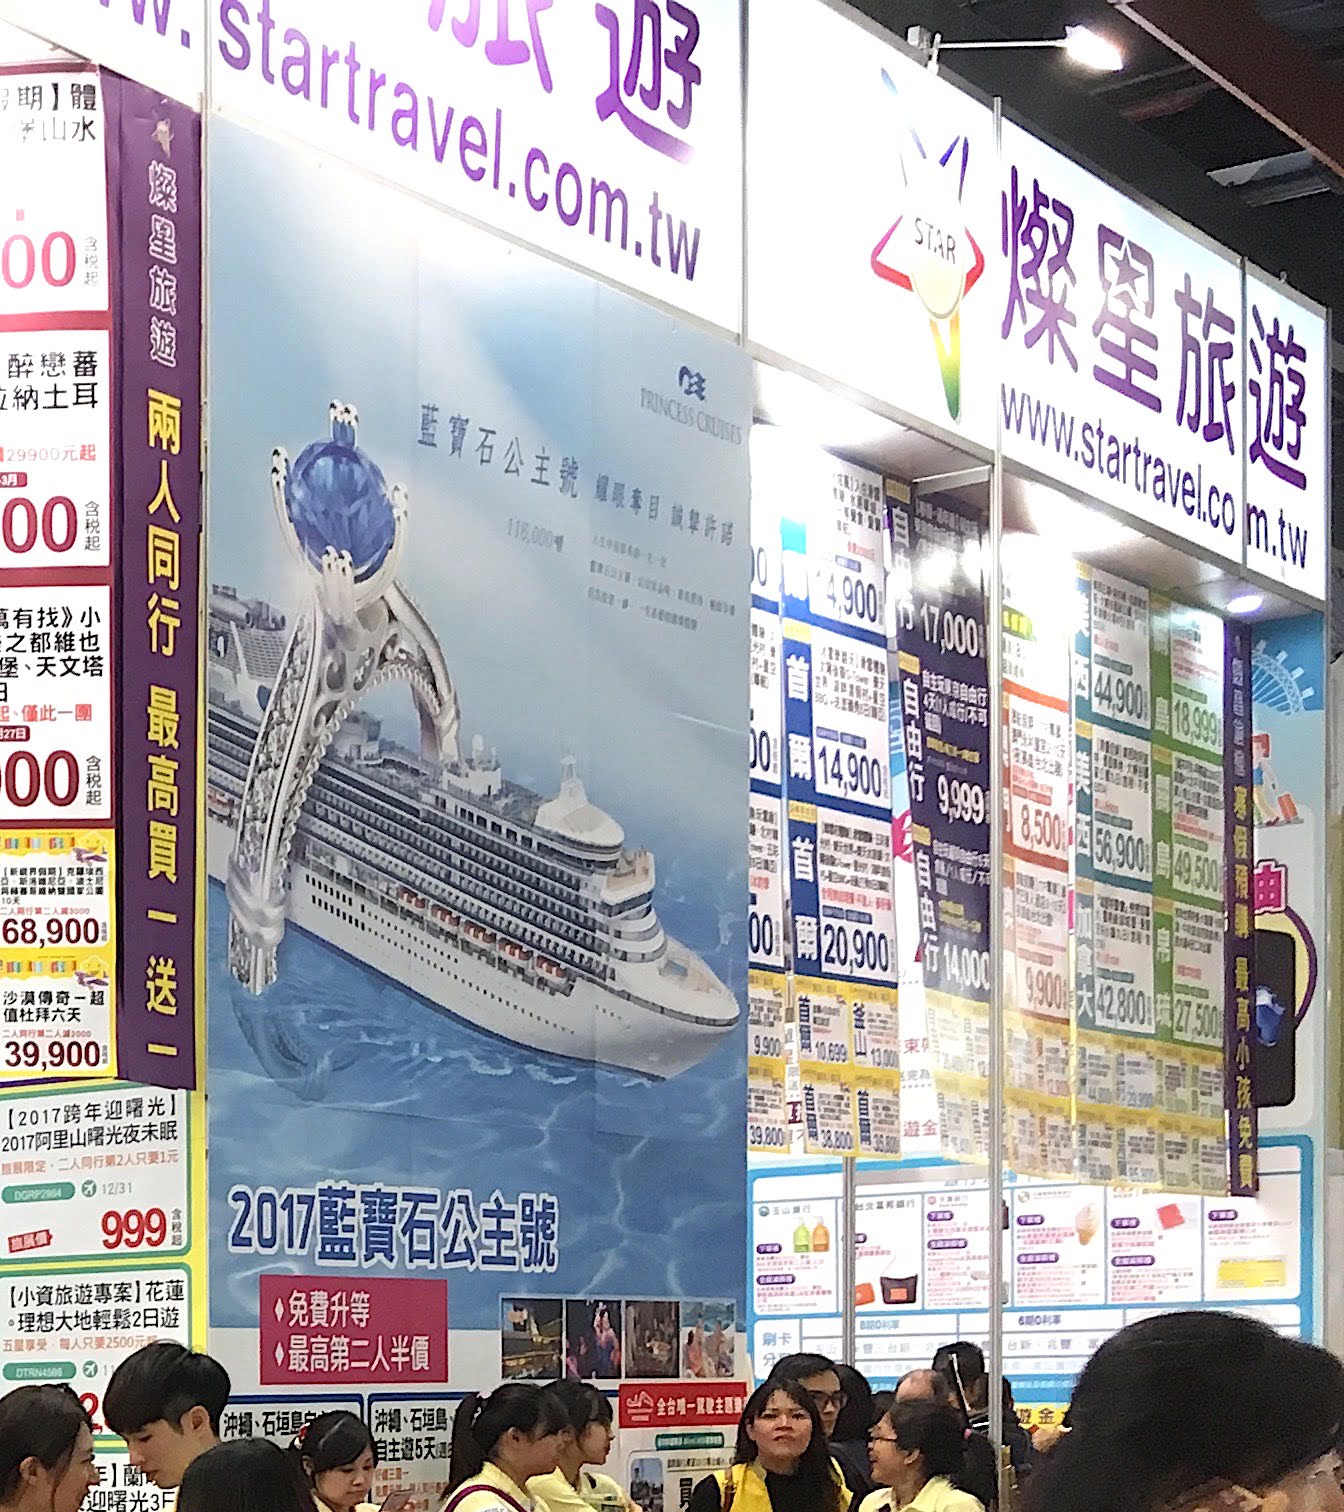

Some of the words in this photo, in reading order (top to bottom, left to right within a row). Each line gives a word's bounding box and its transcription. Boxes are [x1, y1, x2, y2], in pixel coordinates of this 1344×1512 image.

[146, 159, 178, 369] 燦星旅遊
[999, 164, 1308, 491] 燦星旅遊
[640, 387, 694, 428] PRINCESS
[417, 402, 580, 499] 藍寶石公主號
[999, 382, 1309, 570] www.startravel.com.tw
[147, 388, 182, 658] 兩人同行
[1093, 671, 1143, 720] 44,900
[818, 745, 882, 798] 14,900
[145, 684, 182, 1058] 最高買一送一
[2, 918, 100, 949] 68,900
[823, 924, 888, 973] 20,900
[4, 1040, 101, 1072] 39,900
[1, 1119, 178, 1154] 2017阿里山曙光夜未眠
[4, 1095, 179, 1132] 【2017跨年迎曙光】
[101, 1181, 133, 1195] 12/31
[101, 1207, 168, 1250] 999
[230, 1183, 558, 1270] 2017藍寶石公主號
[8, 1280, 185, 1310] 【小資旅遊專案】花蓮
[288, 1290, 370, 1327] 免費升等
[288, 1335, 430, 1373] 最高第二人半價
